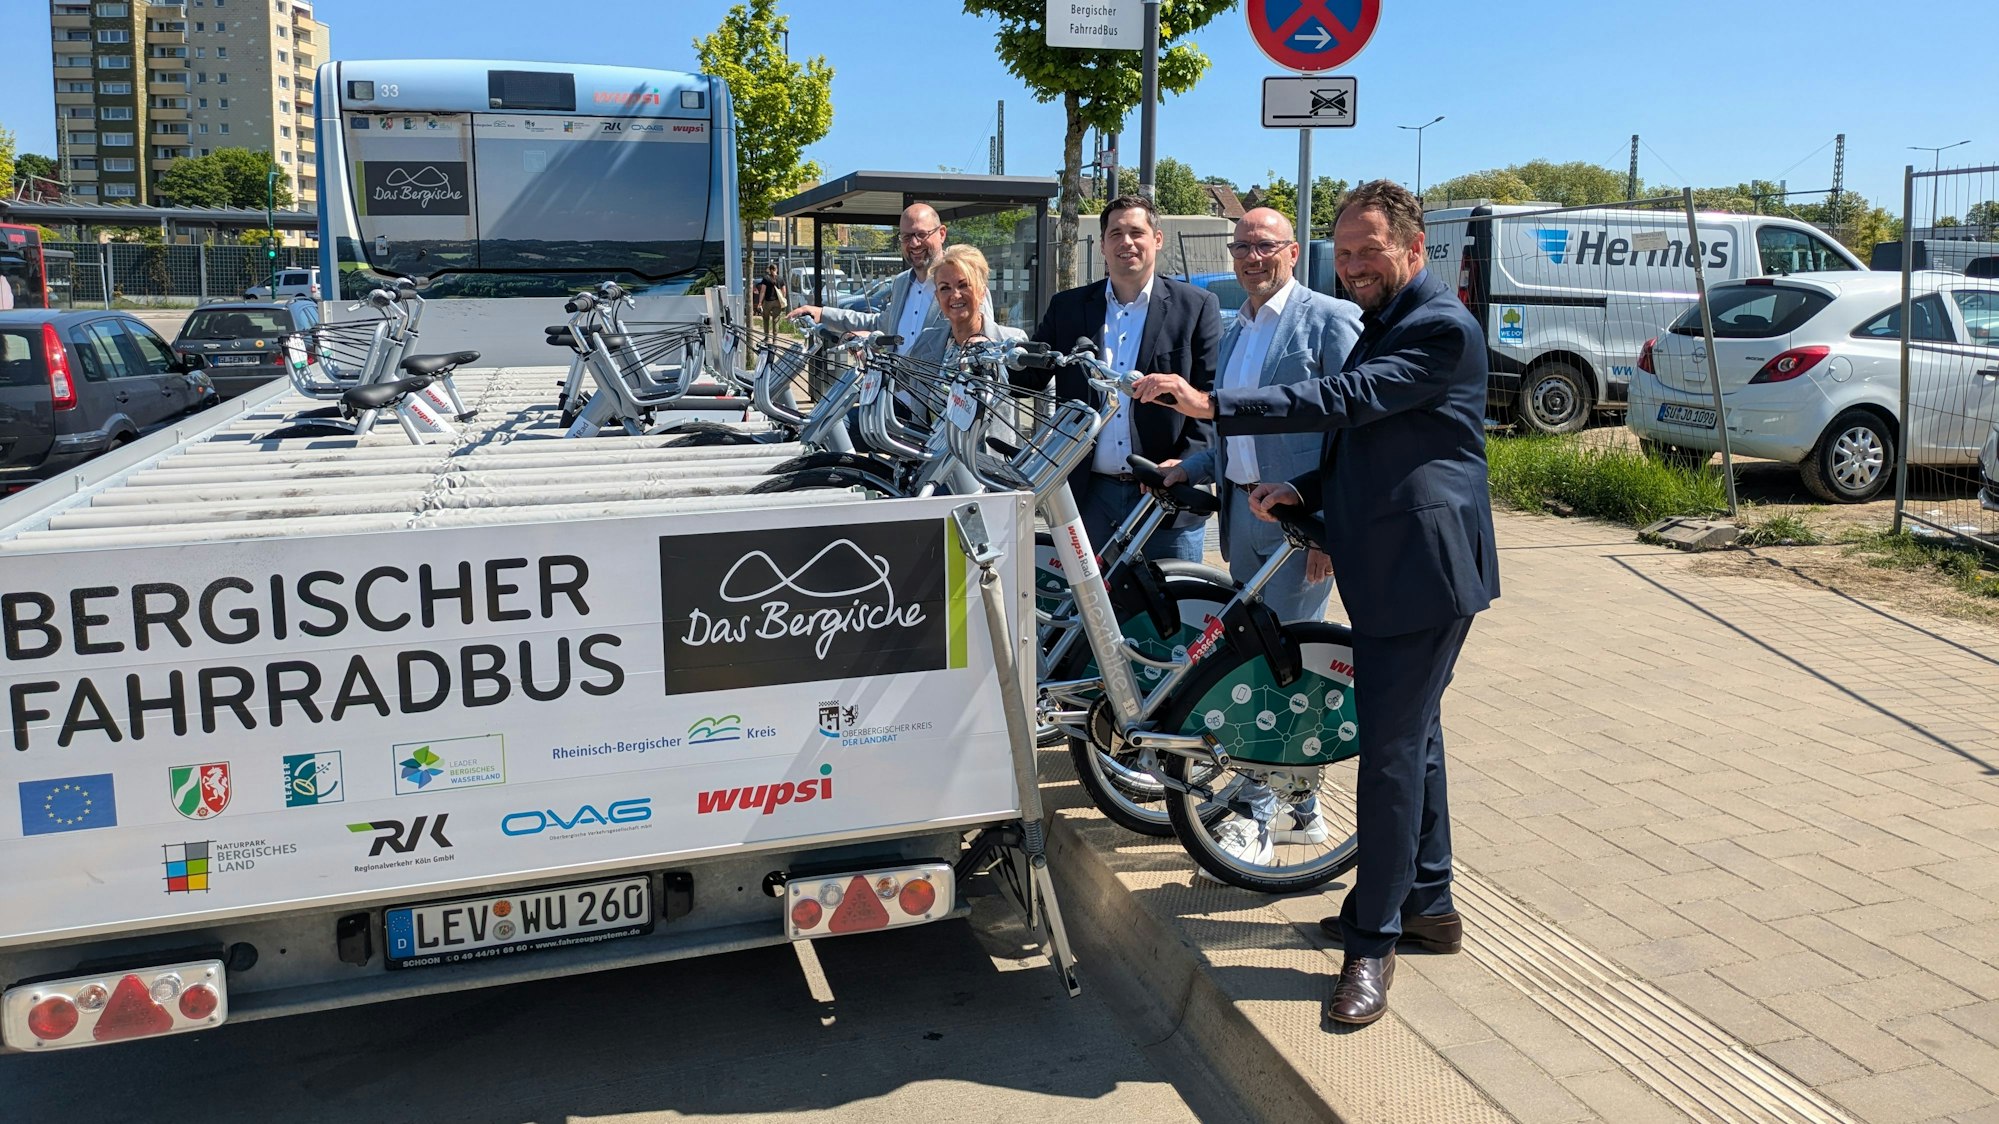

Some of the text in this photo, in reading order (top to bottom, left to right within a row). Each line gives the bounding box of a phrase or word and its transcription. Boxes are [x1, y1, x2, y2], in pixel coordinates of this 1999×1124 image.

[1071, 4, 1117, 17] Bergischer
[1070, 23, 1118, 36] FahrradBus
[380, 84, 399, 98] 33
[593, 88, 660, 107] wupsi
[673, 123, 704, 134] wupsi
[373, 185, 462, 208] Das Bergische
[1664, 406, 1676, 419] SU
[1694, 410, 1716, 425] 1098
[1, 554, 591, 661] BERGISCHER
[681, 598, 927, 660] Das Bergische
[1082, 590, 1128, 692] nextbike
[9, 633, 626, 752] FAHRRADBUS
[842, 721, 933, 738] OBERBERGISCHER KREIS
[552, 726, 777, 760] Rheinisch-Bergischer Kreis
[842, 734, 898, 747] DER LANDRAT
[449, 758, 478, 767] LEADER
[450, 765, 495, 776] BERGISCHES
[283, 762, 293, 801] LEADER
[450, 773, 501, 784] WASSERLAND
[697, 763, 833, 815] wupsi
[501, 797, 652, 837] OVAG
[216, 839, 266, 850] NATURPARK
[217, 843, 297, 862] BERGISCHES
[218, 859, 255, 873] LAND
[354, 854, 455, 873] Regionalverkehr Köln GmbH
[417, 884, 643, 949] LEV WU 260
[397, 938, 407, 950] D
[403, 957, 441, 968] SCHOON
[461, 953, 473, 961] 49
[475, 948, 500, 959] 44/91
[535, 928, 641, 950] www.fahrzeugsysteme.de
